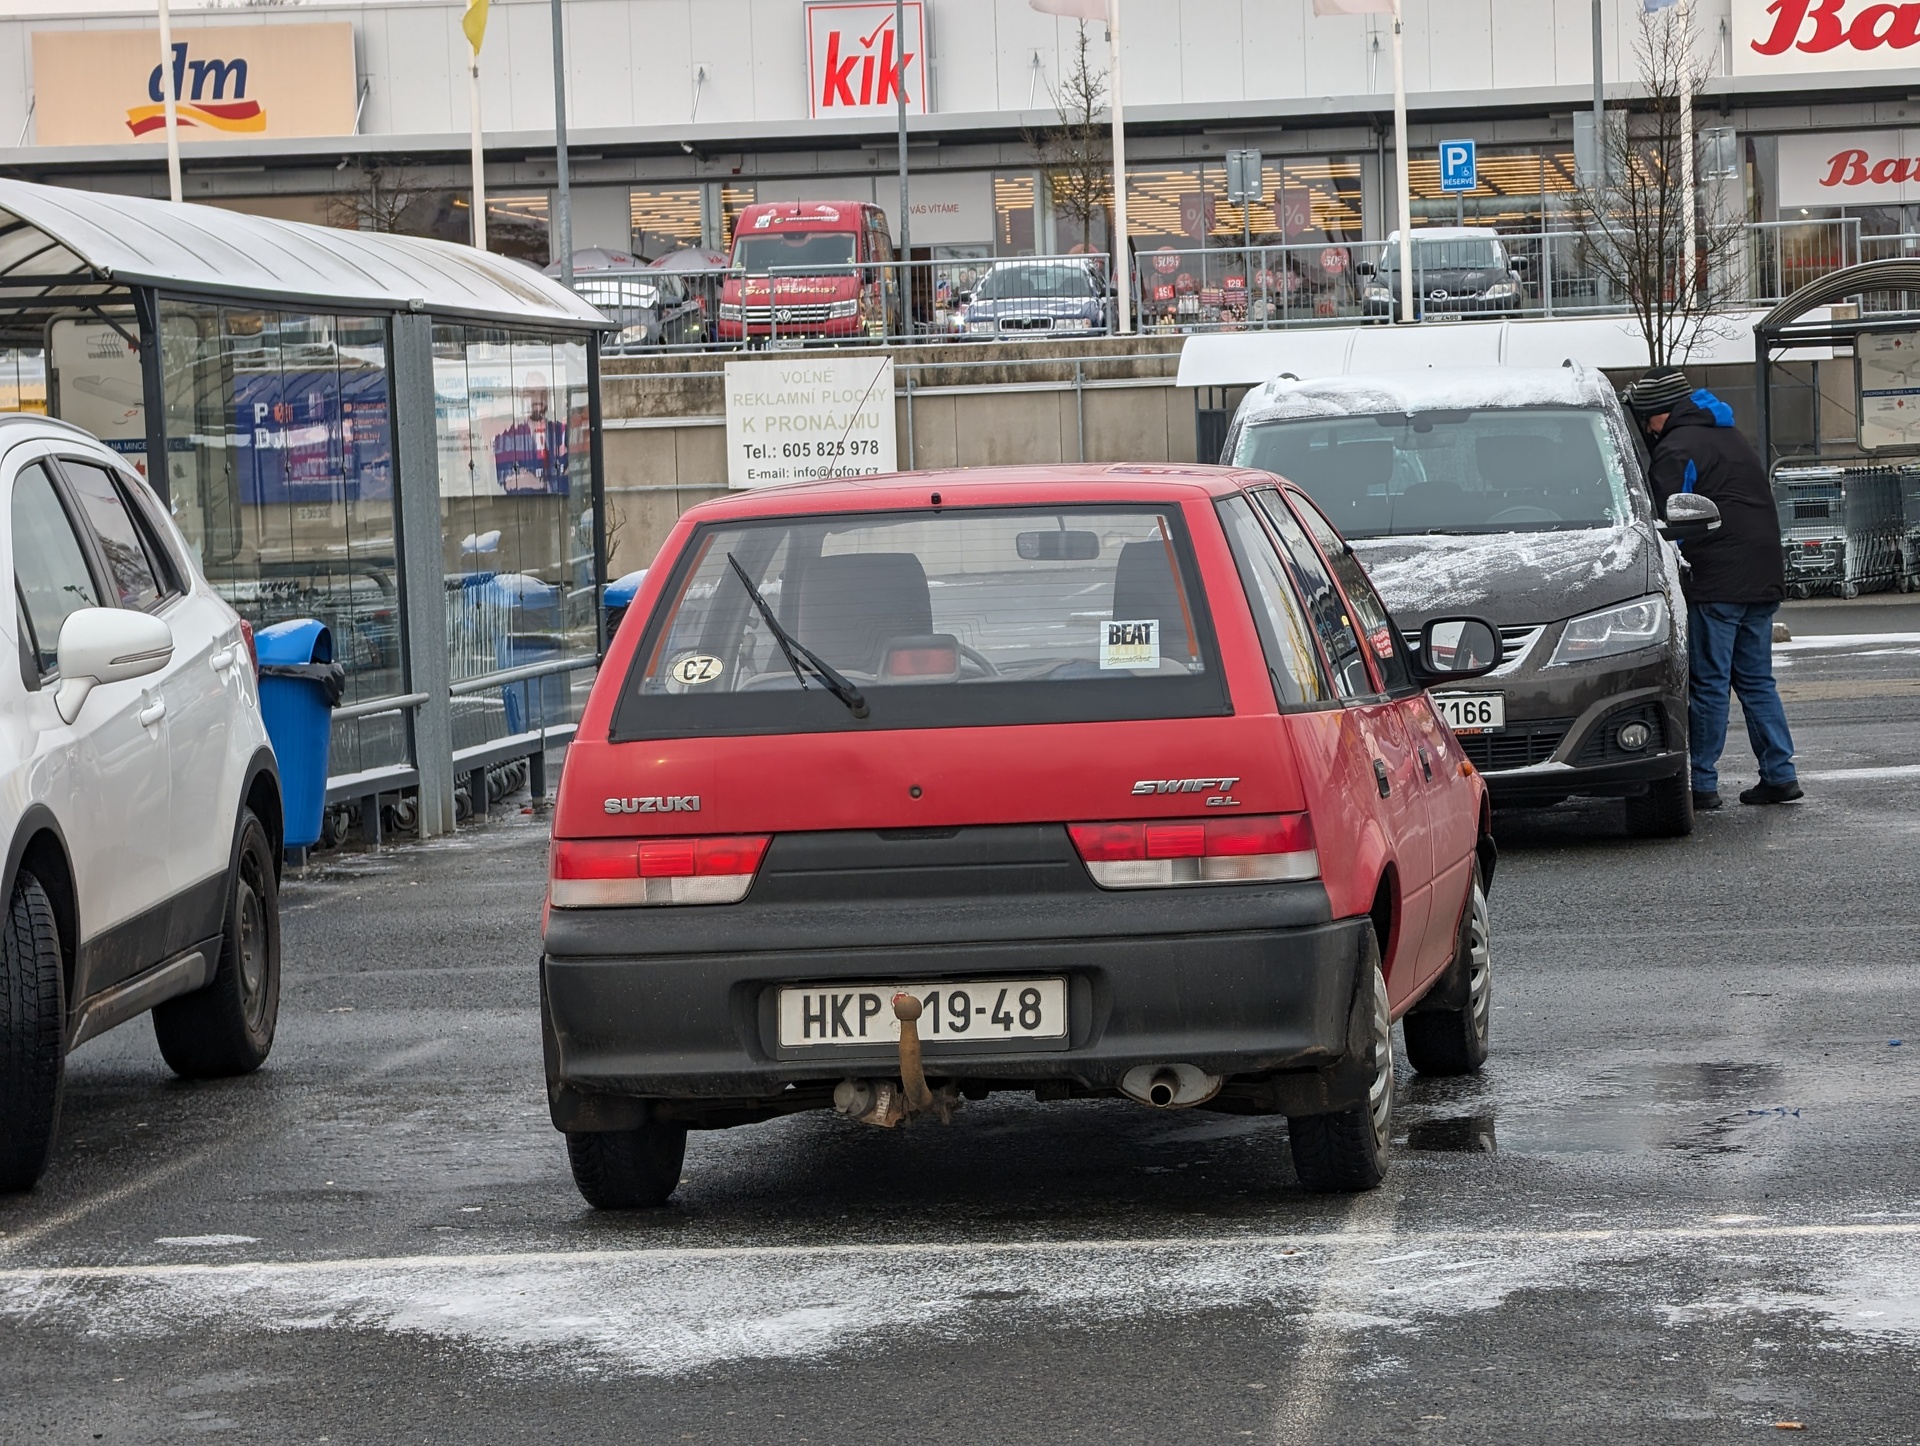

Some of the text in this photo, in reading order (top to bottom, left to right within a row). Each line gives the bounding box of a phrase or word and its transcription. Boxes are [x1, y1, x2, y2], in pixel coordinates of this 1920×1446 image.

[822, 13, 915, 107] kik
[148, 42, 247, 102] dm
[1447, 147, 1469, 176] P
[1819, 149, 1920, 186] Ba
[1444, 177, 1474, 186] RÉSERVÉ
[910, 203, 960, 214] VÁS VÍTÁME
[782, 367, 834, 384] VOLNÉ
[733, 388, 887, 406] REKLAMNÍ PLOCHY
[742, 410, 880, 433] K PRONÁJMU
[124, 441, 147, 450] MINCE
[743, 440, 879, 459] Tel.: 605 825 978
[747, 466, 879, 480] E-mail: info@rofoxcz
[1108, 622, 1154, 645] BEAT
[684, 659, 713, 680] CZ
[1131, 777, 1240, 795] SWIFT
[604, 795, 701, 814] SUZUKI
[1206, 796, 1241, 806] GL
[803, 988, 1042, 1038] HKP 19-48
